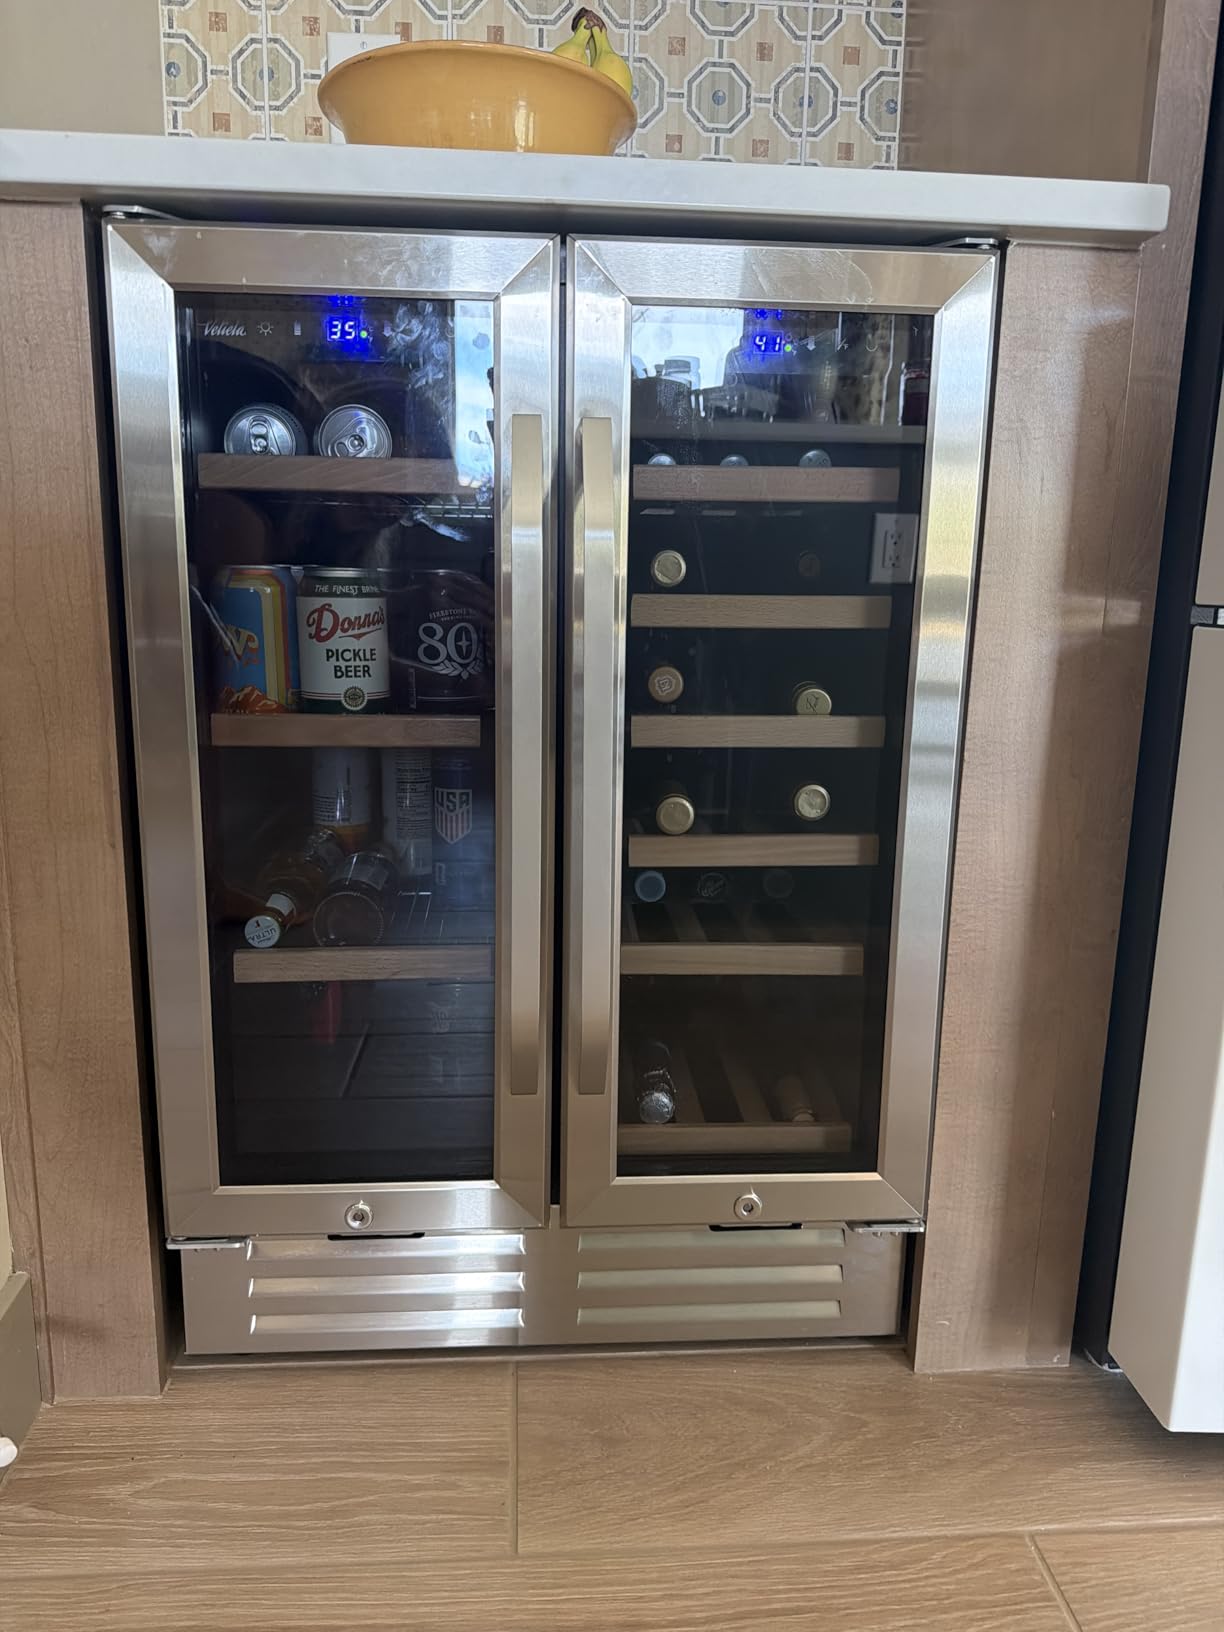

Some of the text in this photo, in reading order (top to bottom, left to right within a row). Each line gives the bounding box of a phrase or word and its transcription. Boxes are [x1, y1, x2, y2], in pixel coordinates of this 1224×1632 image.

[331, 321, 355, 340] 35
[755, 335, 783, 353] 41
[315, 585, 329, 593] THE
[332, 585, 359, 595] FINEST
[306, 602, 386, 643] Donna's
[417, 622, 478, 665] 80
[325, 648, 377, 662] PICKLE
[334, 664, 372, 680] BEER
[435, 789, 470, 813] USA
[247, 927, 277, 942] ULTRA
